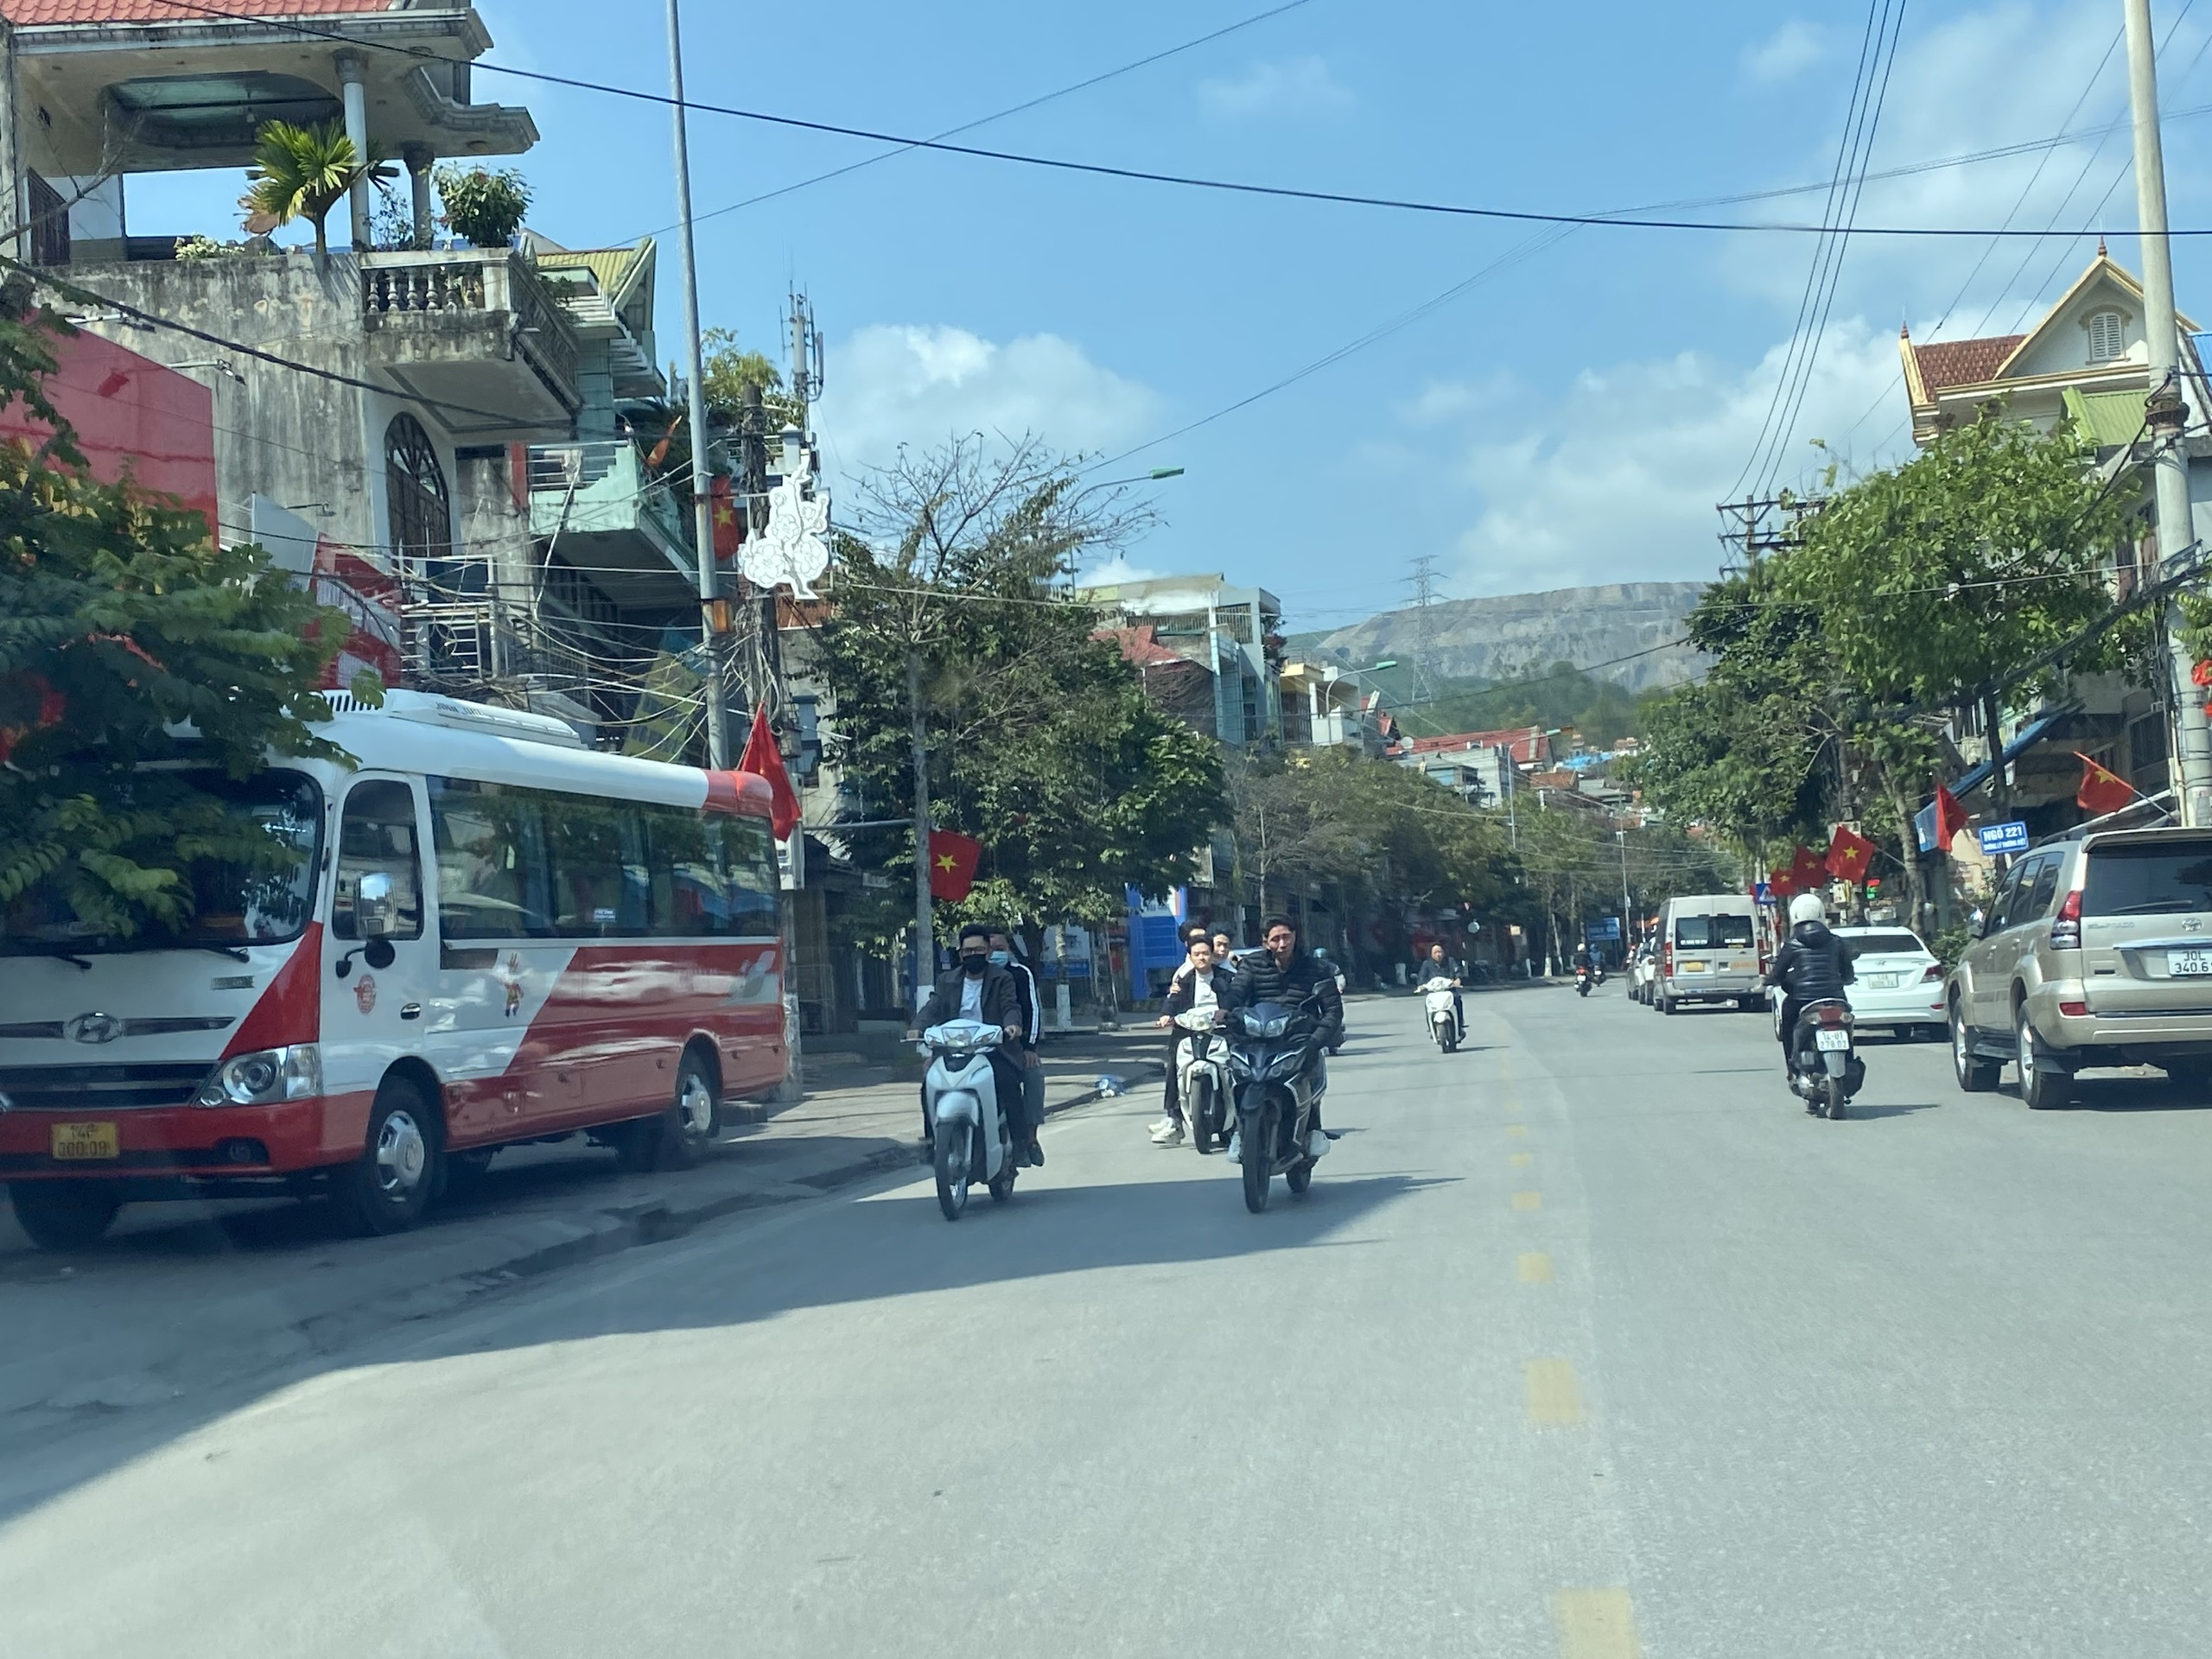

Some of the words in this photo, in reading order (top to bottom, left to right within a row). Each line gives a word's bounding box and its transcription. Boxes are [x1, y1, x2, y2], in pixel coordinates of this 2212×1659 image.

[2005, 825, 2022, 838] 221
[2183, 950, 2206, 962] 30L
[2174, 962, 2212, 973] 340.6
